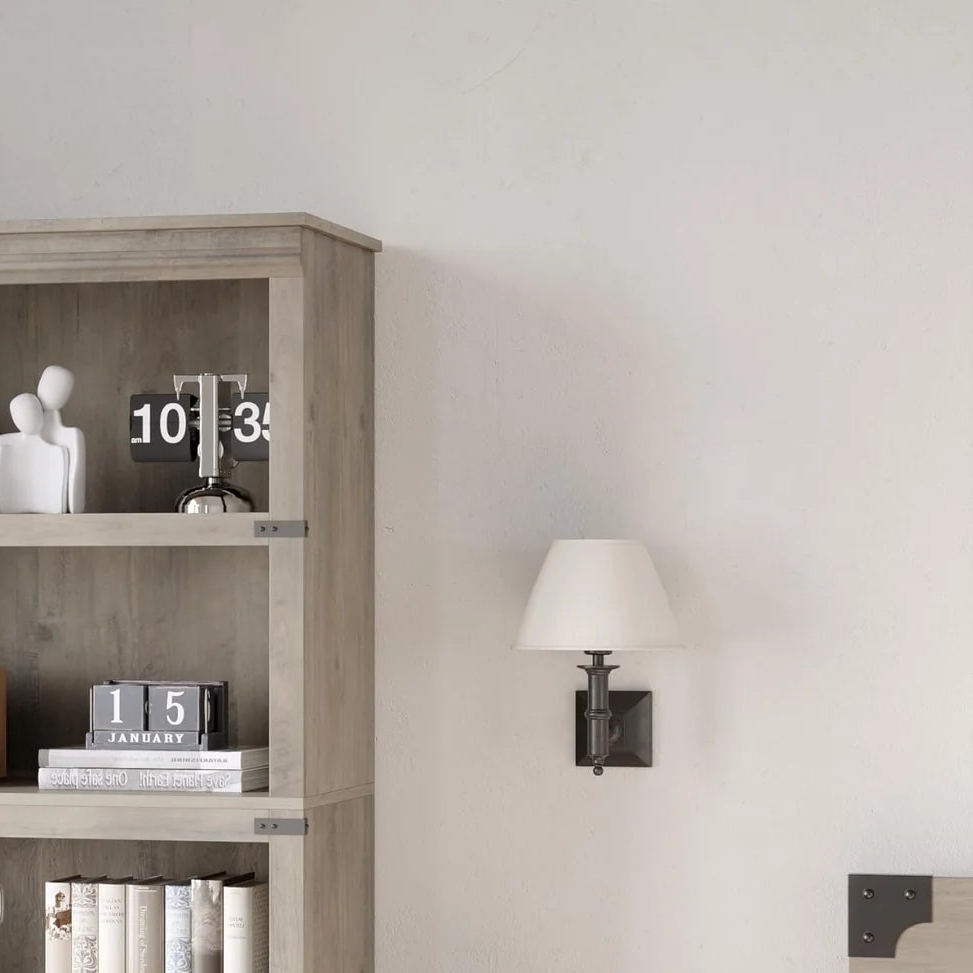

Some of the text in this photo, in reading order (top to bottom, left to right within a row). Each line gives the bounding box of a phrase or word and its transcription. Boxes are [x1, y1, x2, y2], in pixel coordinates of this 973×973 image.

[133, 402, 187, 444] 10
[110, 688, 185, 726] 1 5
[107, 732, 185, 744] JANUARY
